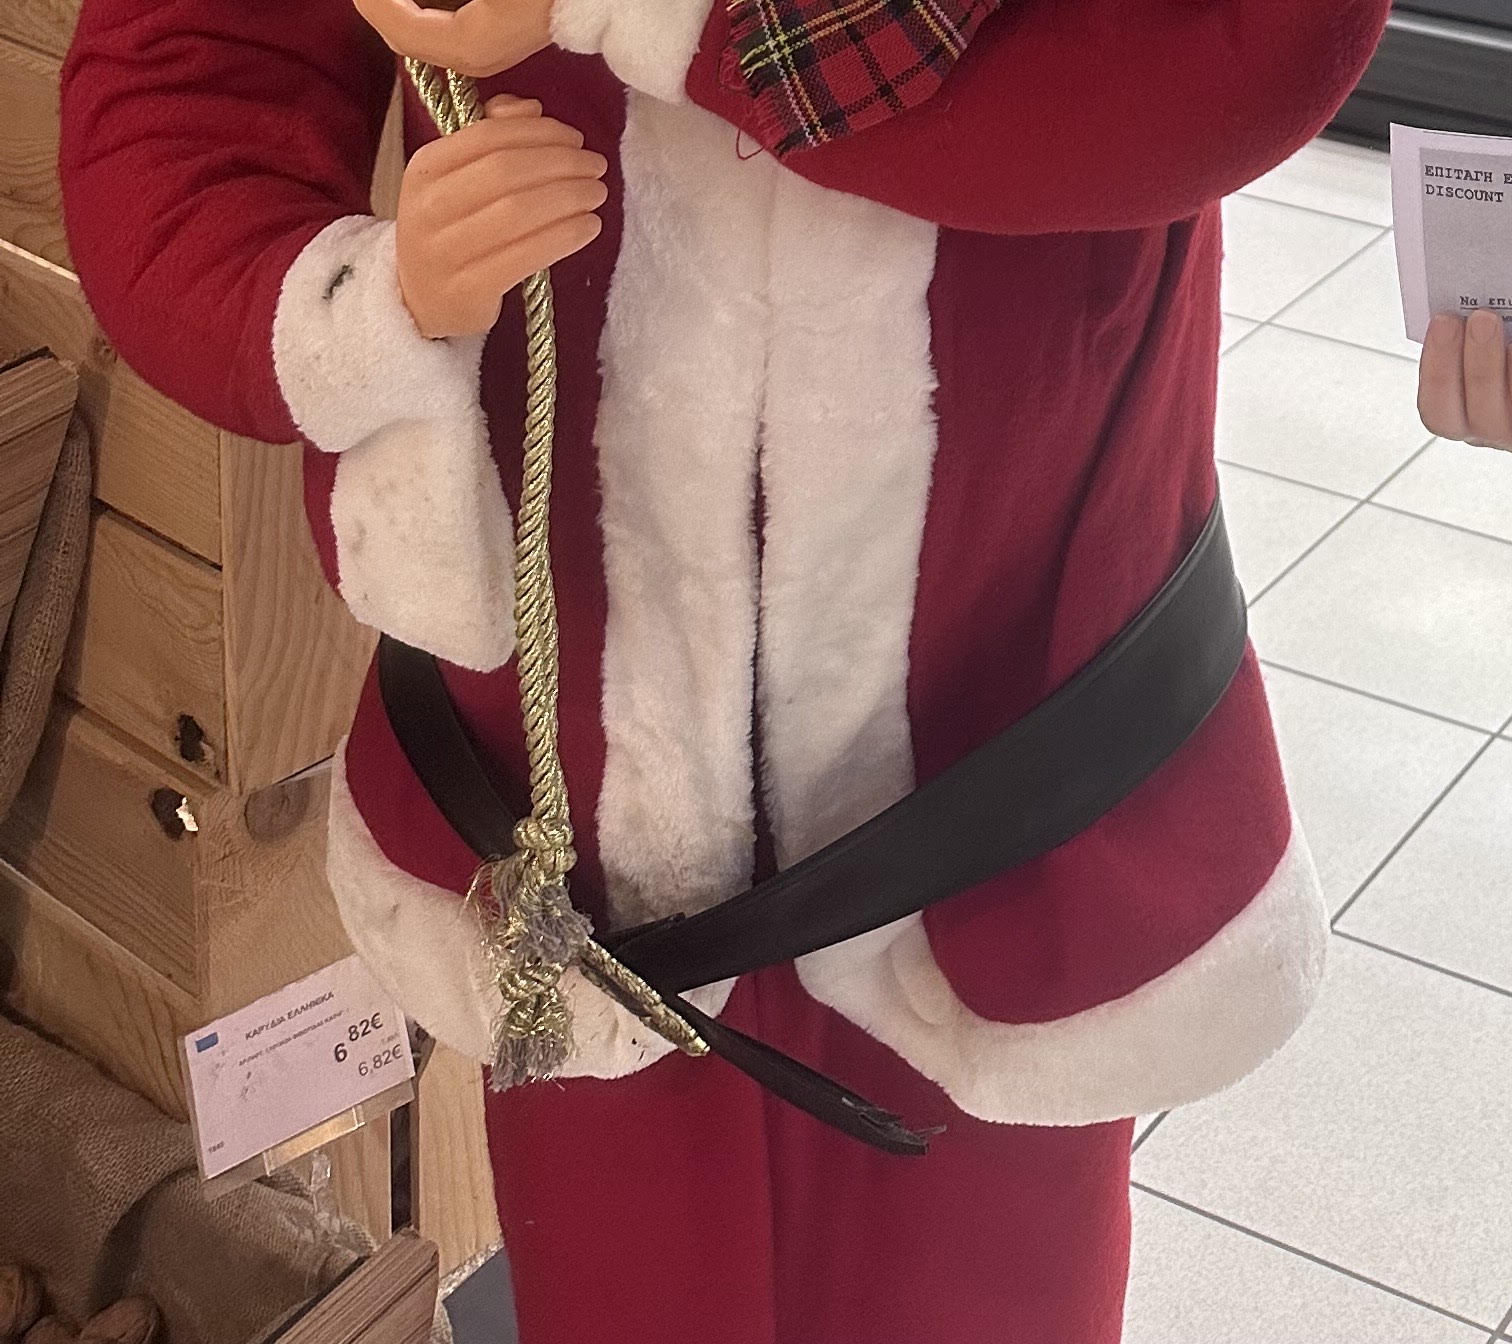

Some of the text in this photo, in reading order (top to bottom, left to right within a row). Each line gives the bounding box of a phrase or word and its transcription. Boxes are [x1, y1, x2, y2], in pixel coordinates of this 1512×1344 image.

[1425, 165, 1493, 182] ΕΠΙΤΑΓΗ
[1426, 184, 1504, 202] DISCOUNT
[1460, 296, 1478, 306] Να
[334, 1012, 383, 1063] 6 82€
